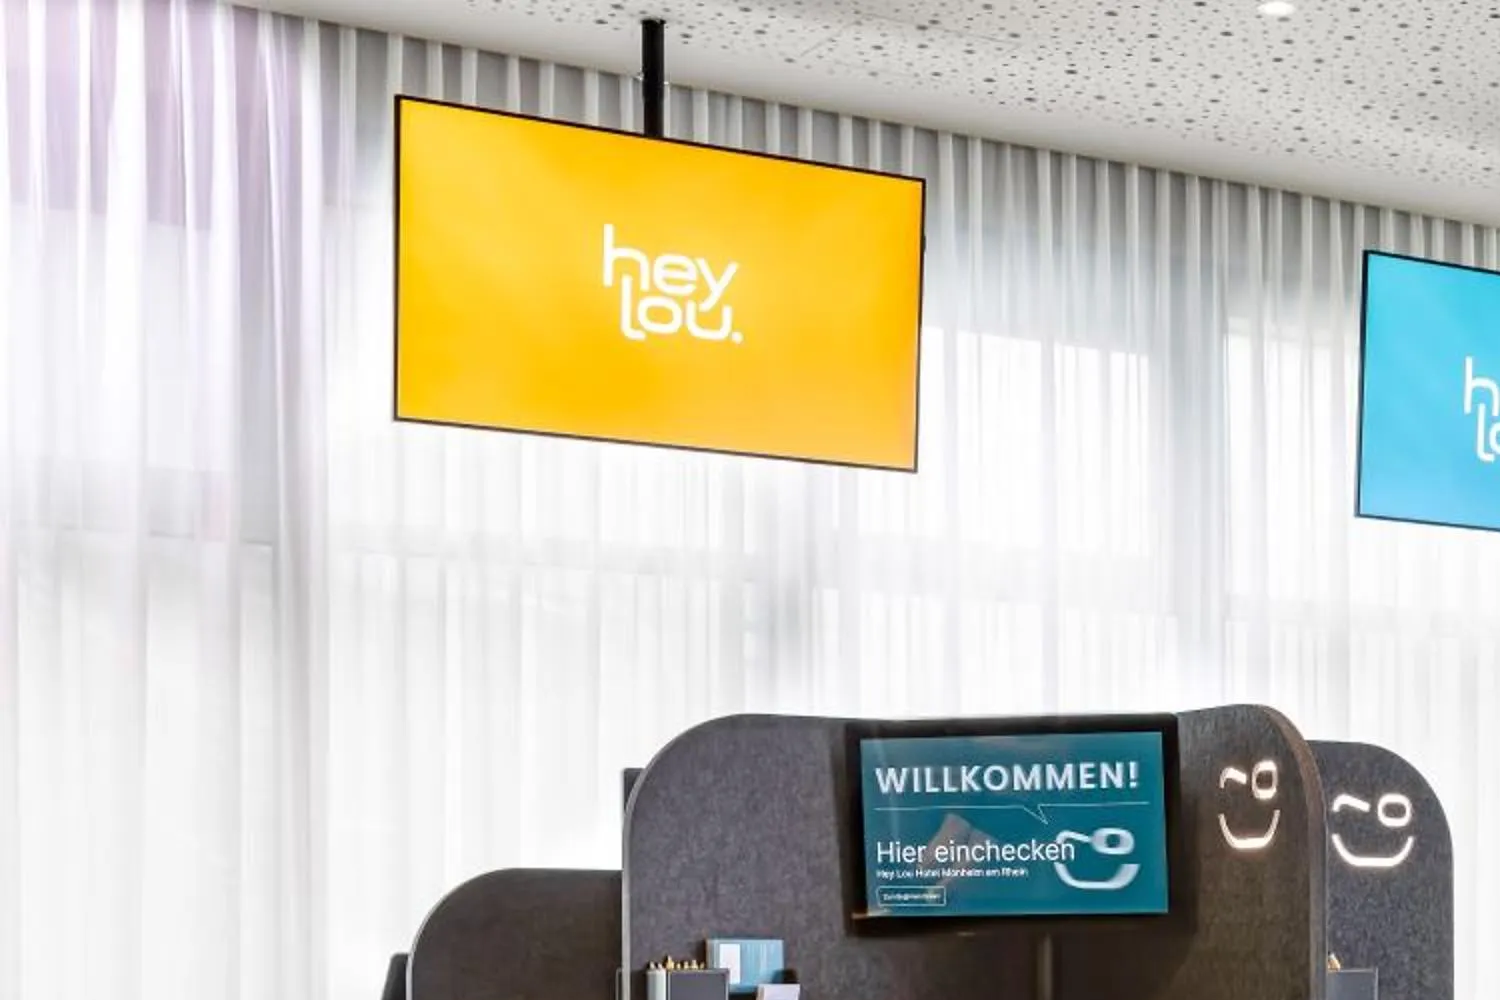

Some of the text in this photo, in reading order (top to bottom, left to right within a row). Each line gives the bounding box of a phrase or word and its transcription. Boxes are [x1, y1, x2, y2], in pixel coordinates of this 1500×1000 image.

[602, 223, 739, 312] hey
[620, 273, 744, 344] lou.
[874, 761, 1139, 794] WILLKOMMEN!
[876, 838, 1076, 864] Hier einchecken
